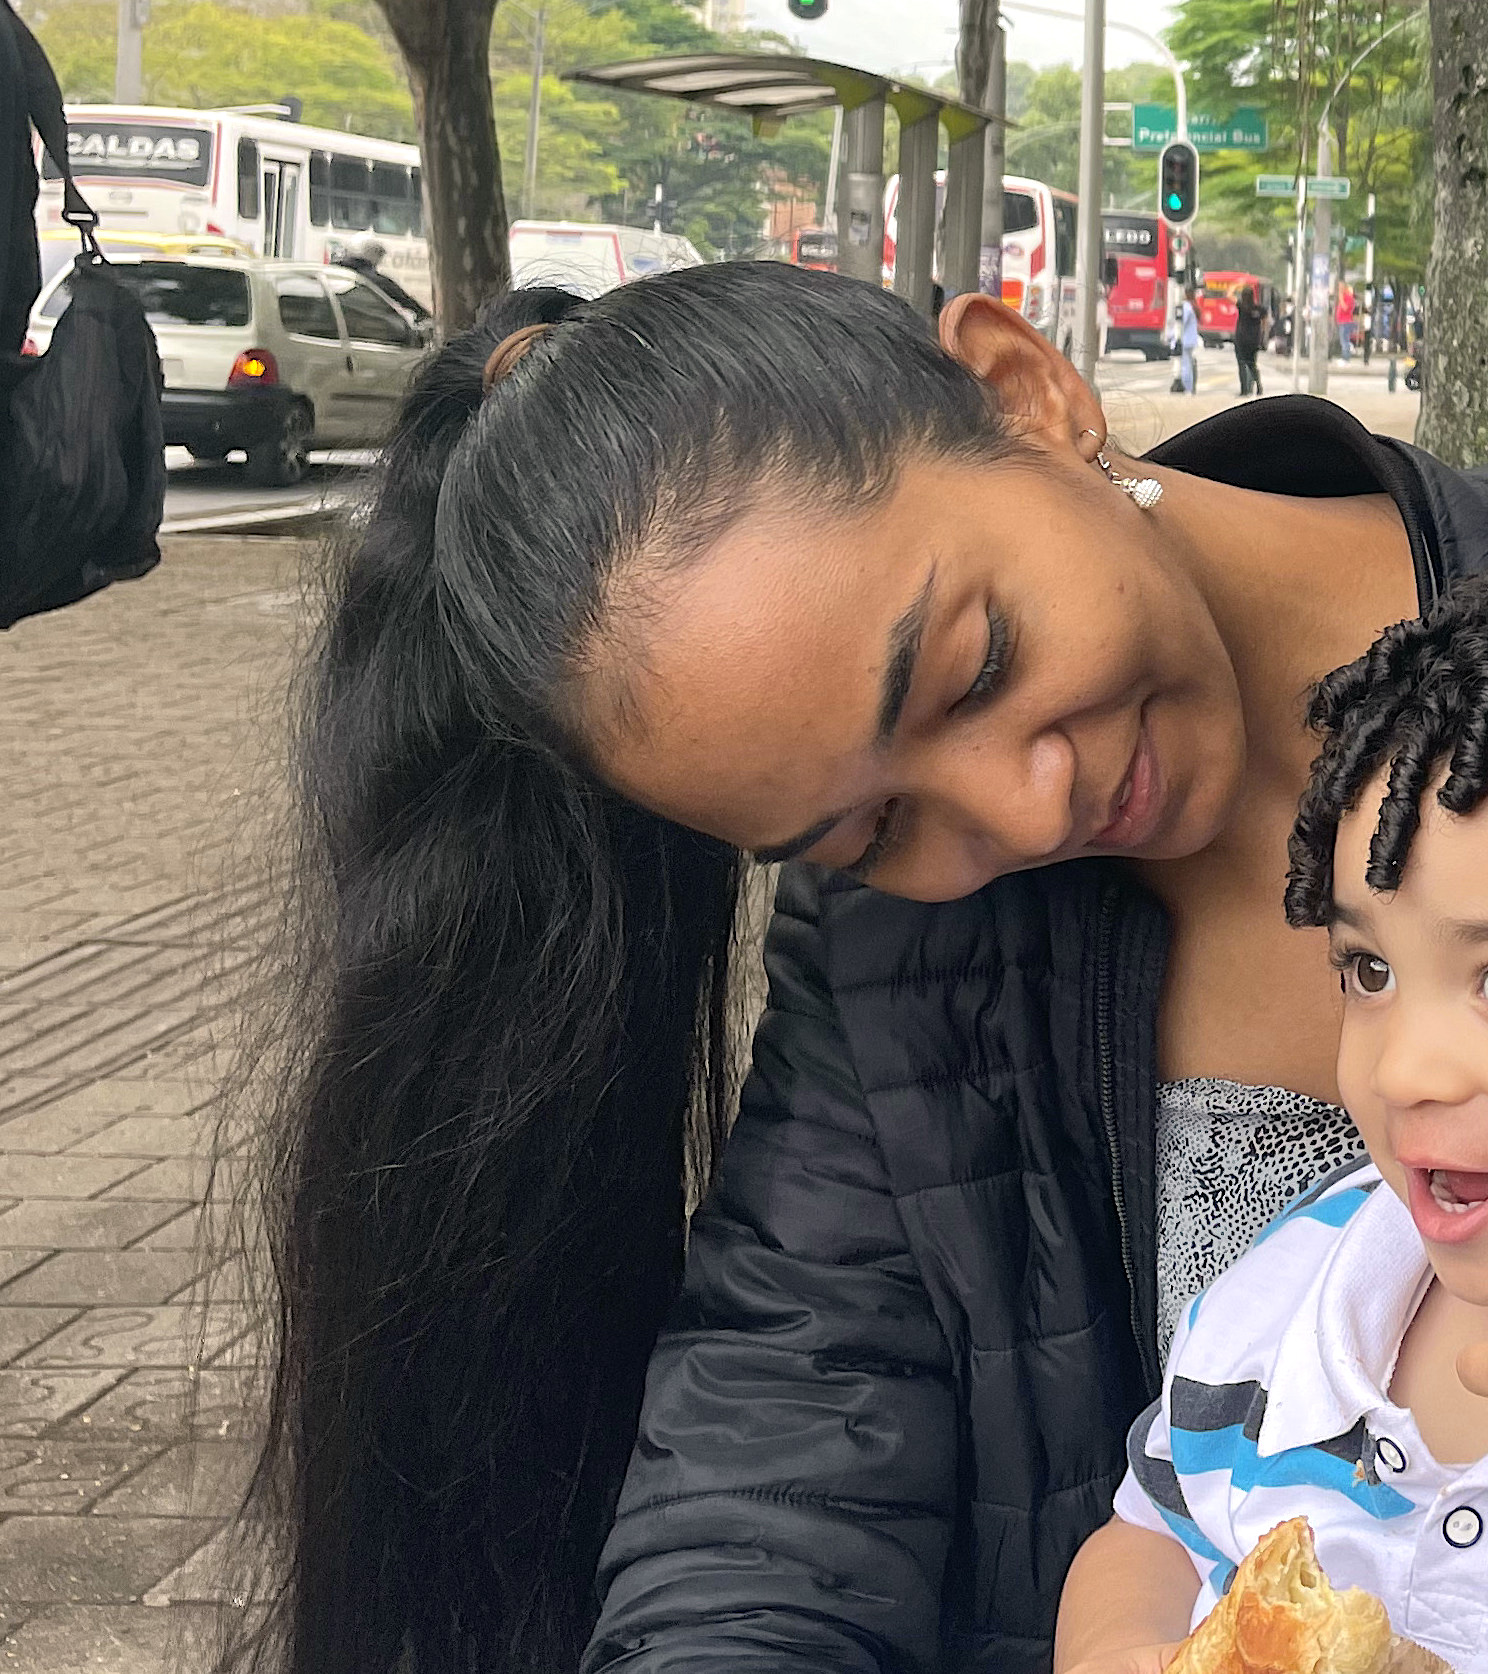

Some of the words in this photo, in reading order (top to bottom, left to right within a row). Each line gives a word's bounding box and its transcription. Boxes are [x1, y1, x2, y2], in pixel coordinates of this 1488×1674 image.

[67, 132, 201, 161] CALDAS
[1138, 126, 1228, 144] Prefencial
[1232, 128, 1261, 144] Bus
